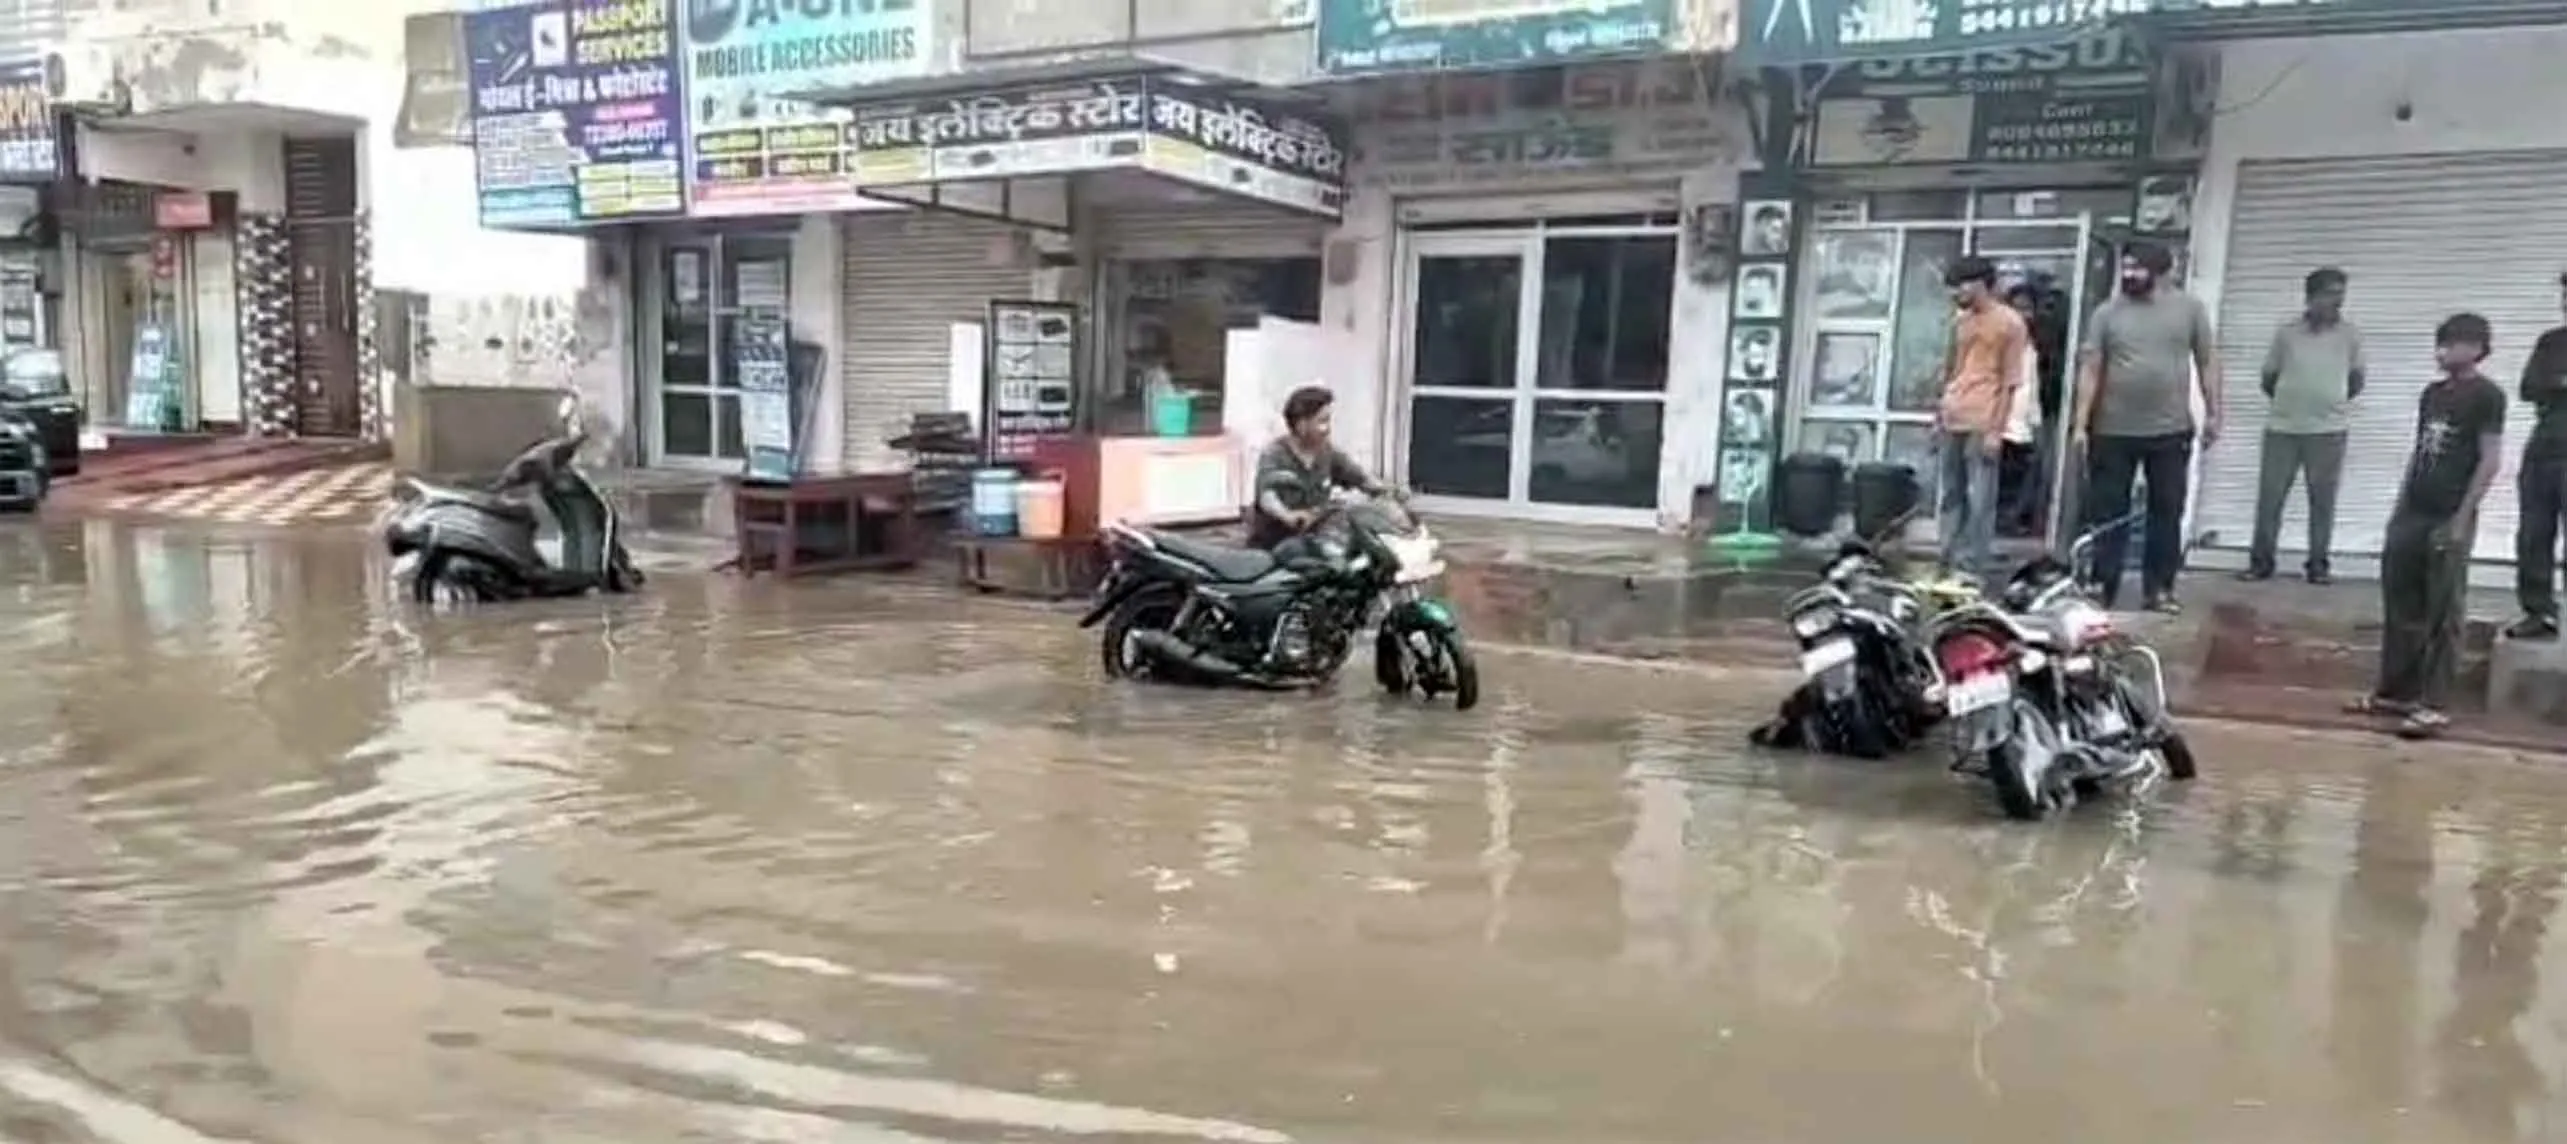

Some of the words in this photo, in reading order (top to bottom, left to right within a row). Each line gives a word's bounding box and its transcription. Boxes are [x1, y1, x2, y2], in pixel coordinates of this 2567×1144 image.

[577, 31, 668, 64] SERVICES
[696, 43, 766, 79] MOBILE
[770, 26, 916, 70] ACCESSORIES
[861, 115, 912, 146] जय
[1067, 83, 1140, 127] स्टोर
[1152, 94, 1197, 136] जय
[1299, 132, 1343, 175] स्टोर
